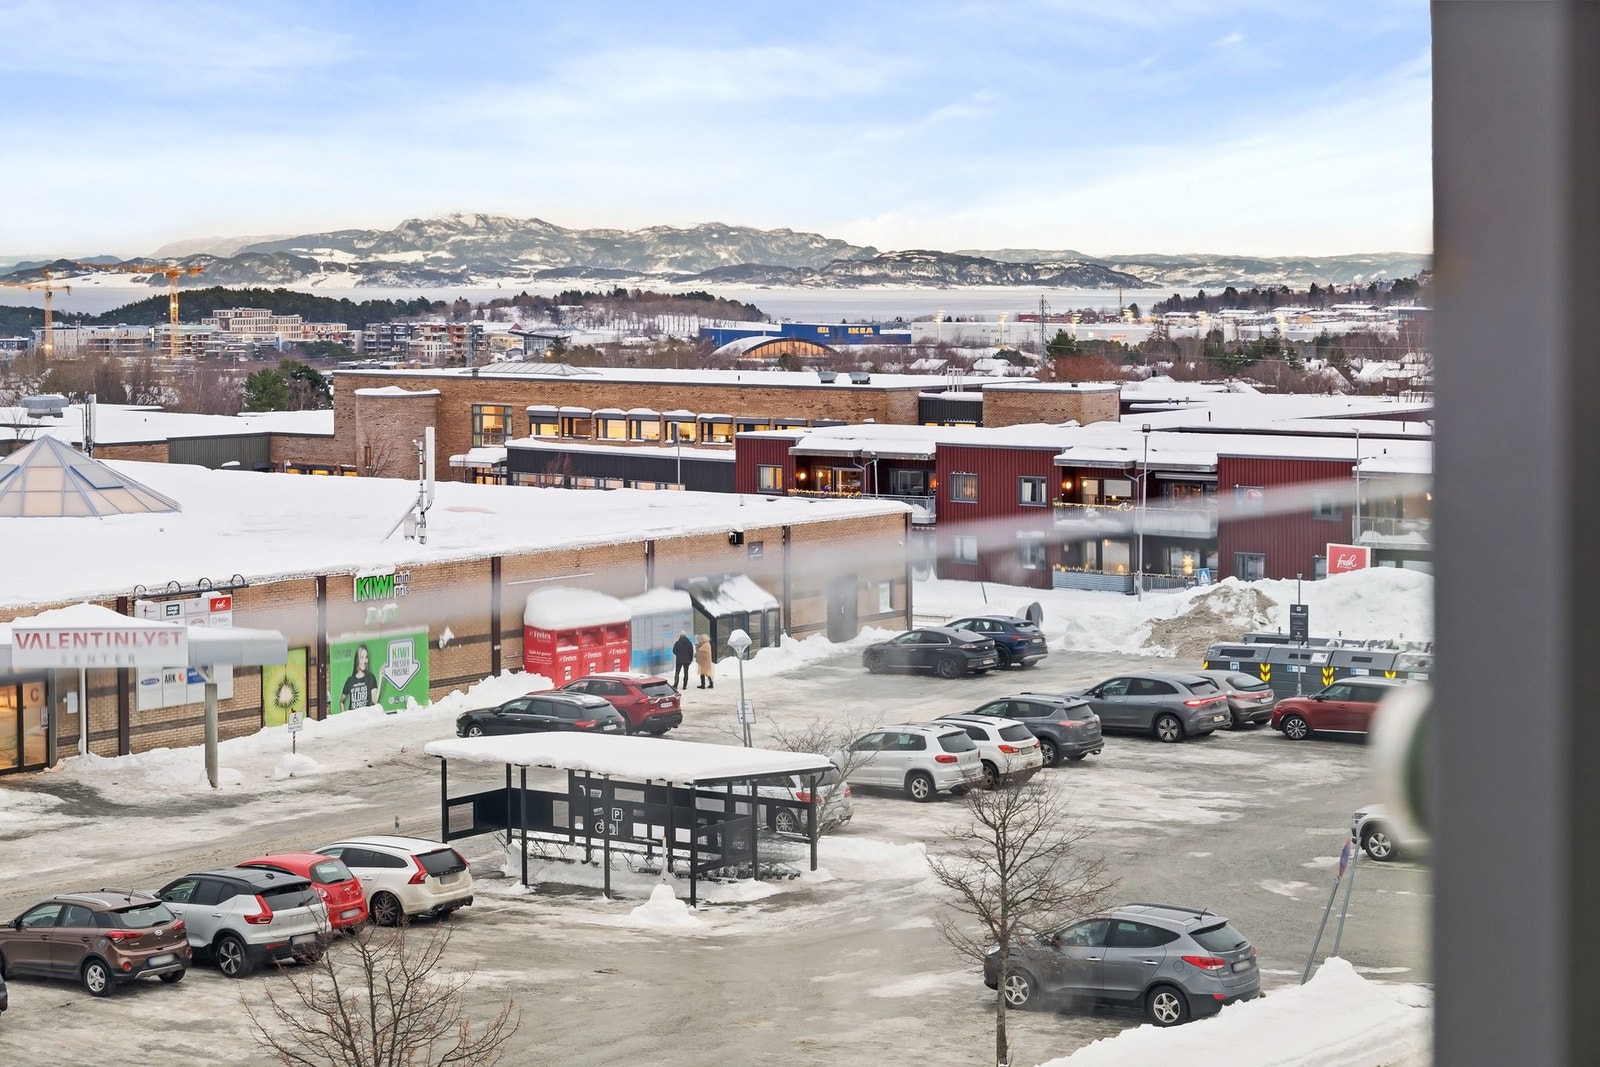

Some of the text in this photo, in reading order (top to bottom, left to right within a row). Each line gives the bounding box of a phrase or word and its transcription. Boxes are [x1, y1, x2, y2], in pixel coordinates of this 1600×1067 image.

[395, 572, 411, 583] mini
[357, 574, 394, 601] KIWI
[15, 631, 183, 650] VALENTINLYST
[392, 646, 410, 659] KIWI
[164, 674, 176, 684] ARK
[30, 688, 39, 702] C
[614, 810, 620, 818] P
